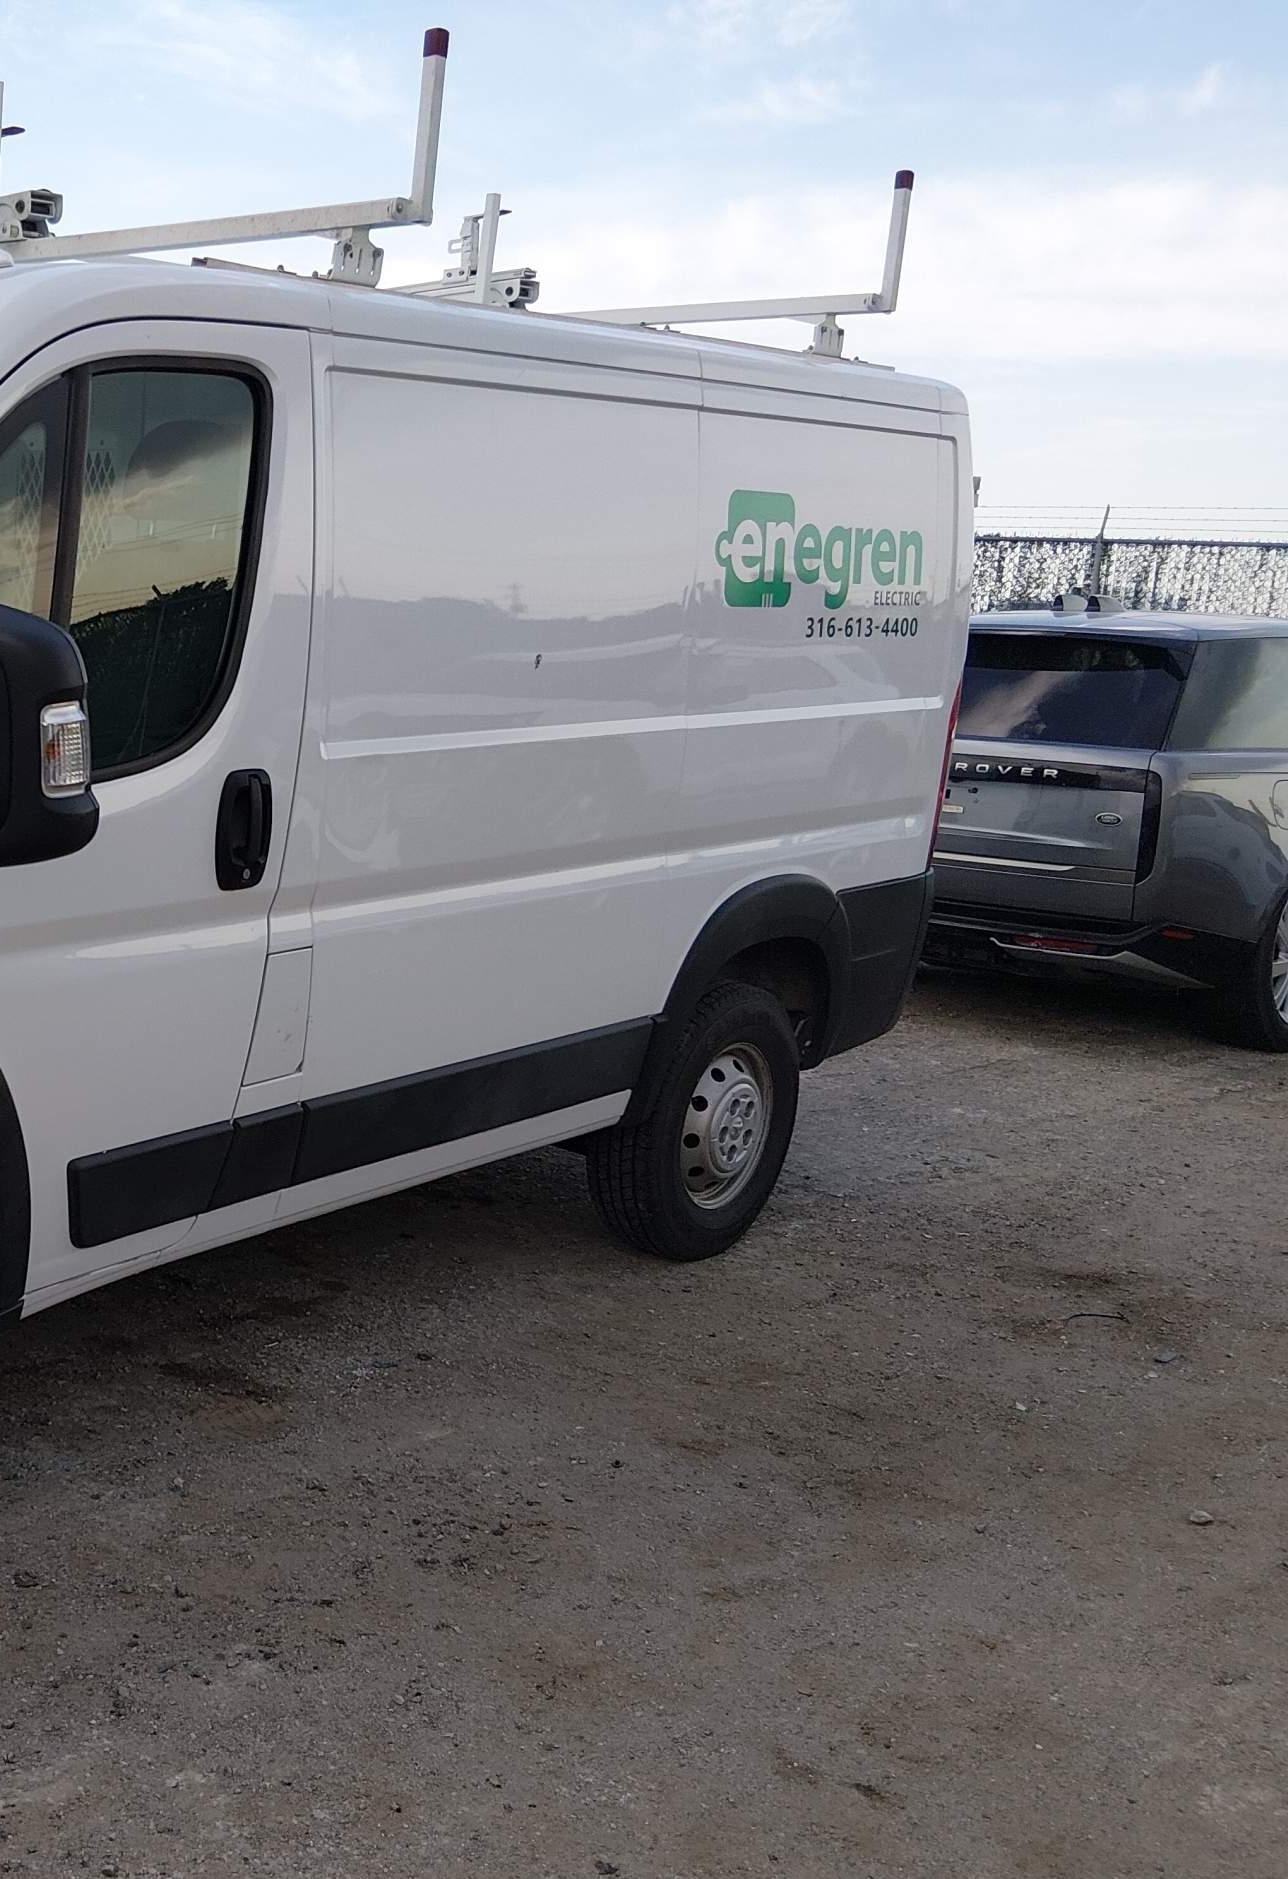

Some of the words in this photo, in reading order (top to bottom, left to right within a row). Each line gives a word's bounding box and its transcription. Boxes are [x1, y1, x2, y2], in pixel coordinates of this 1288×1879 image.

[729, 520, 923, 609] enegren
[873, 590, 921, 606] ELECTRIC
[805, 616, 918, 638] 316-613-4400
[955, 762, 1058, 778] ROVER
